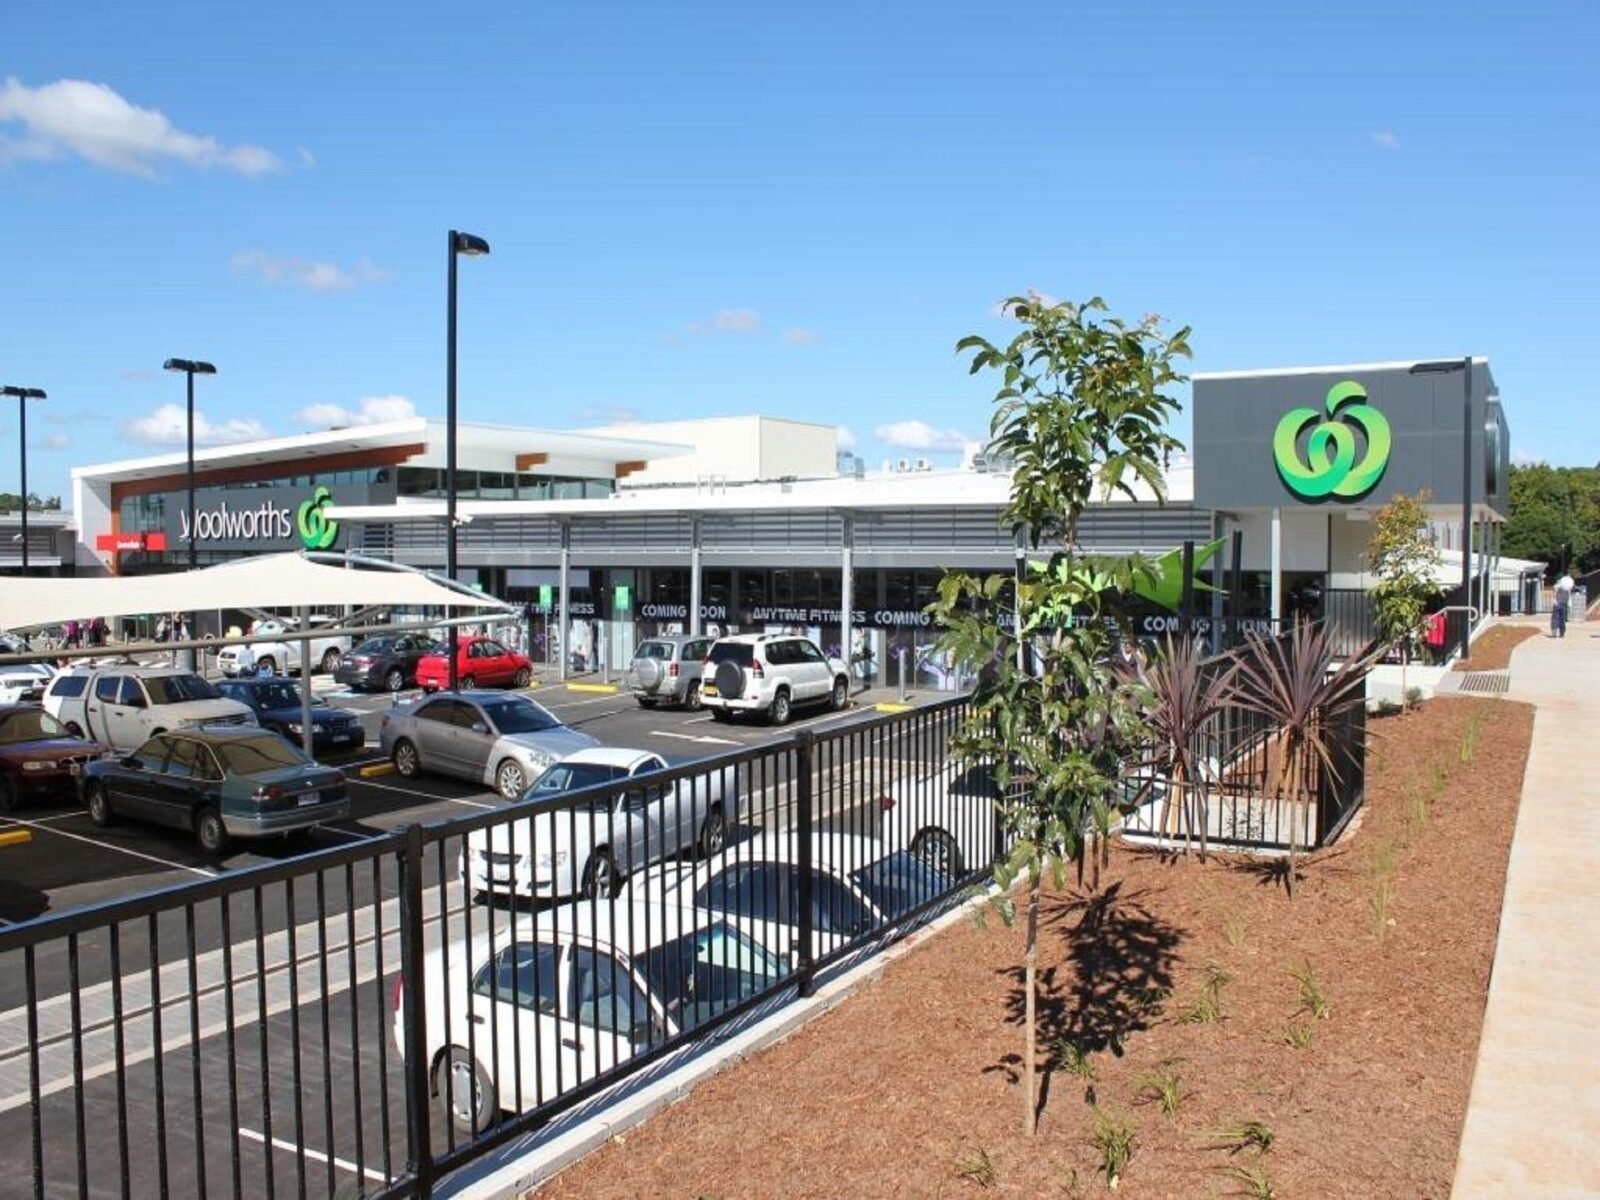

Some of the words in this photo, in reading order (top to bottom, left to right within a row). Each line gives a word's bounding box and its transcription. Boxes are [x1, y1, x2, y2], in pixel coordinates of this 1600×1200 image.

[641, 604, 687, 618] COMING
[698, 605, 727, 619] OON
[752, 606, 808, 621] ANYTIME
[809, 608, 867, 623] FITNSS
[874, 610, 931, 626] COMING
